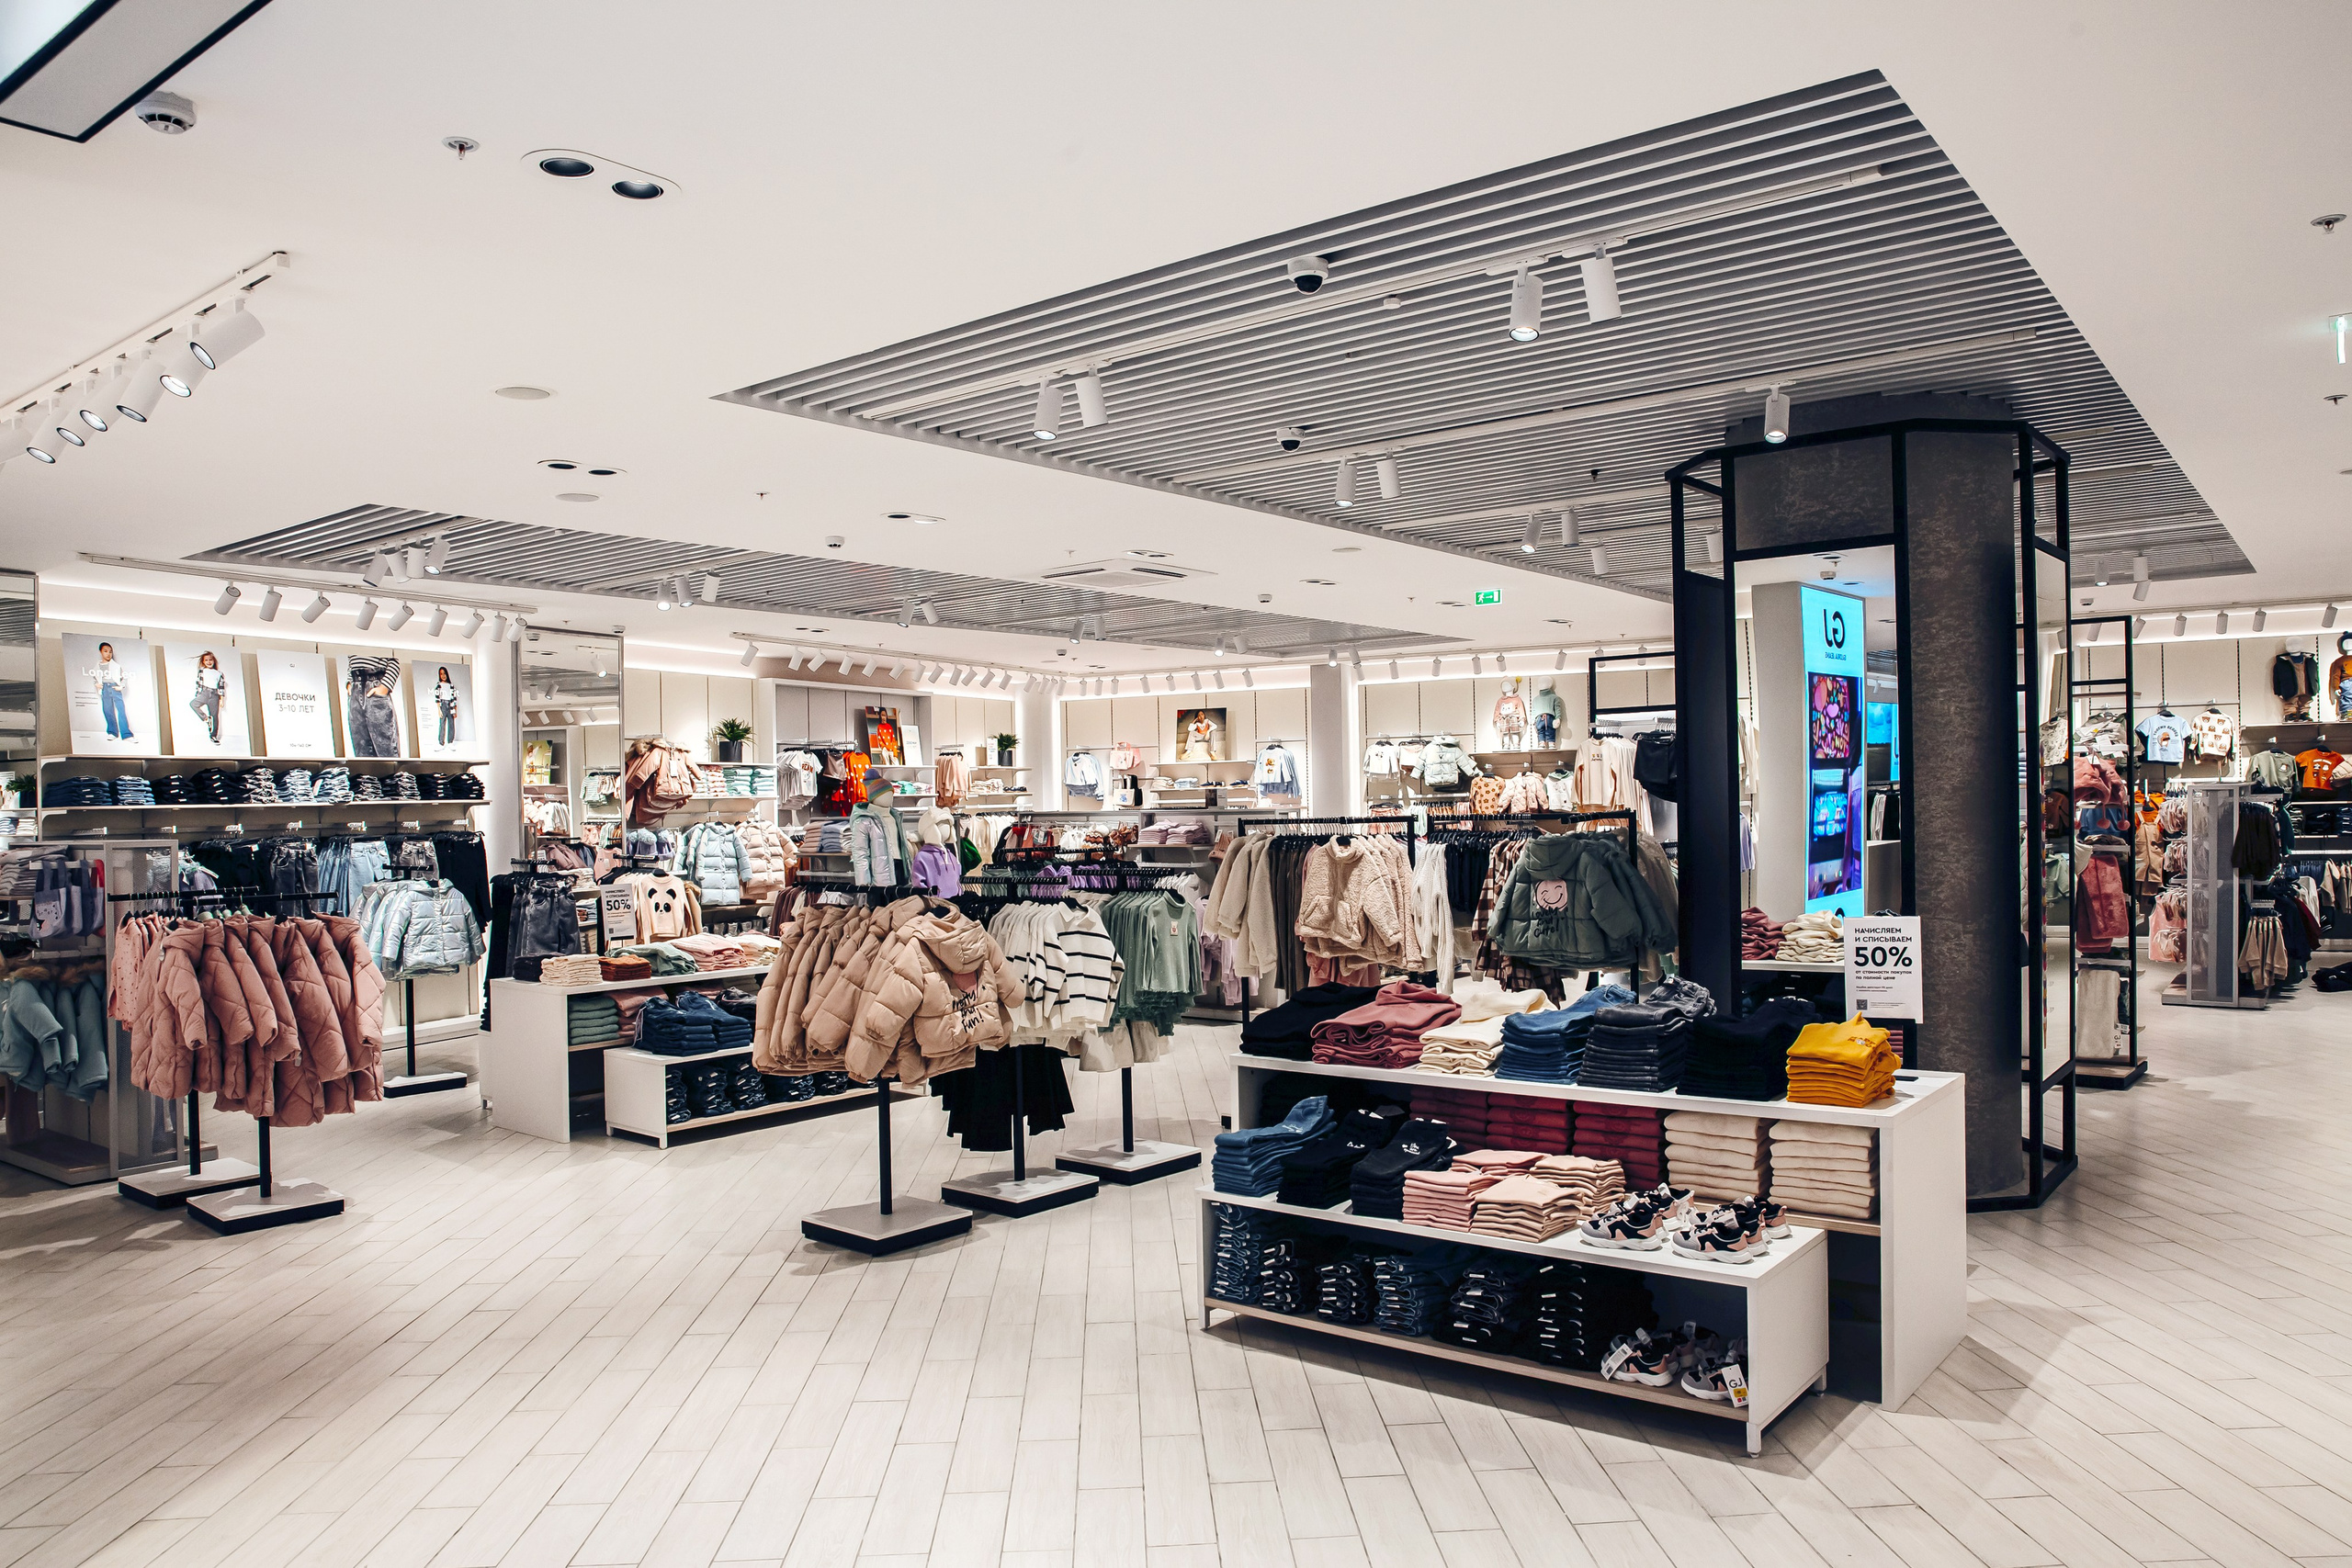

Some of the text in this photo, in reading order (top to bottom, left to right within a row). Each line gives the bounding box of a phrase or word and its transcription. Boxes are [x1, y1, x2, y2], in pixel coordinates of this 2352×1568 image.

[82, 666, 111, 679] Long
[275, 692, 316, 702] ДЕВОЧКИ
[427, 687, 460, 697] Mom Fit
[278, 704, 314, 713] 3-10 ЛЕТ
[605, 899, 631, 911] 50%
[1854, 946, 1913, 967] 50%
[1728, 1377, 1744, 1389] GJ
